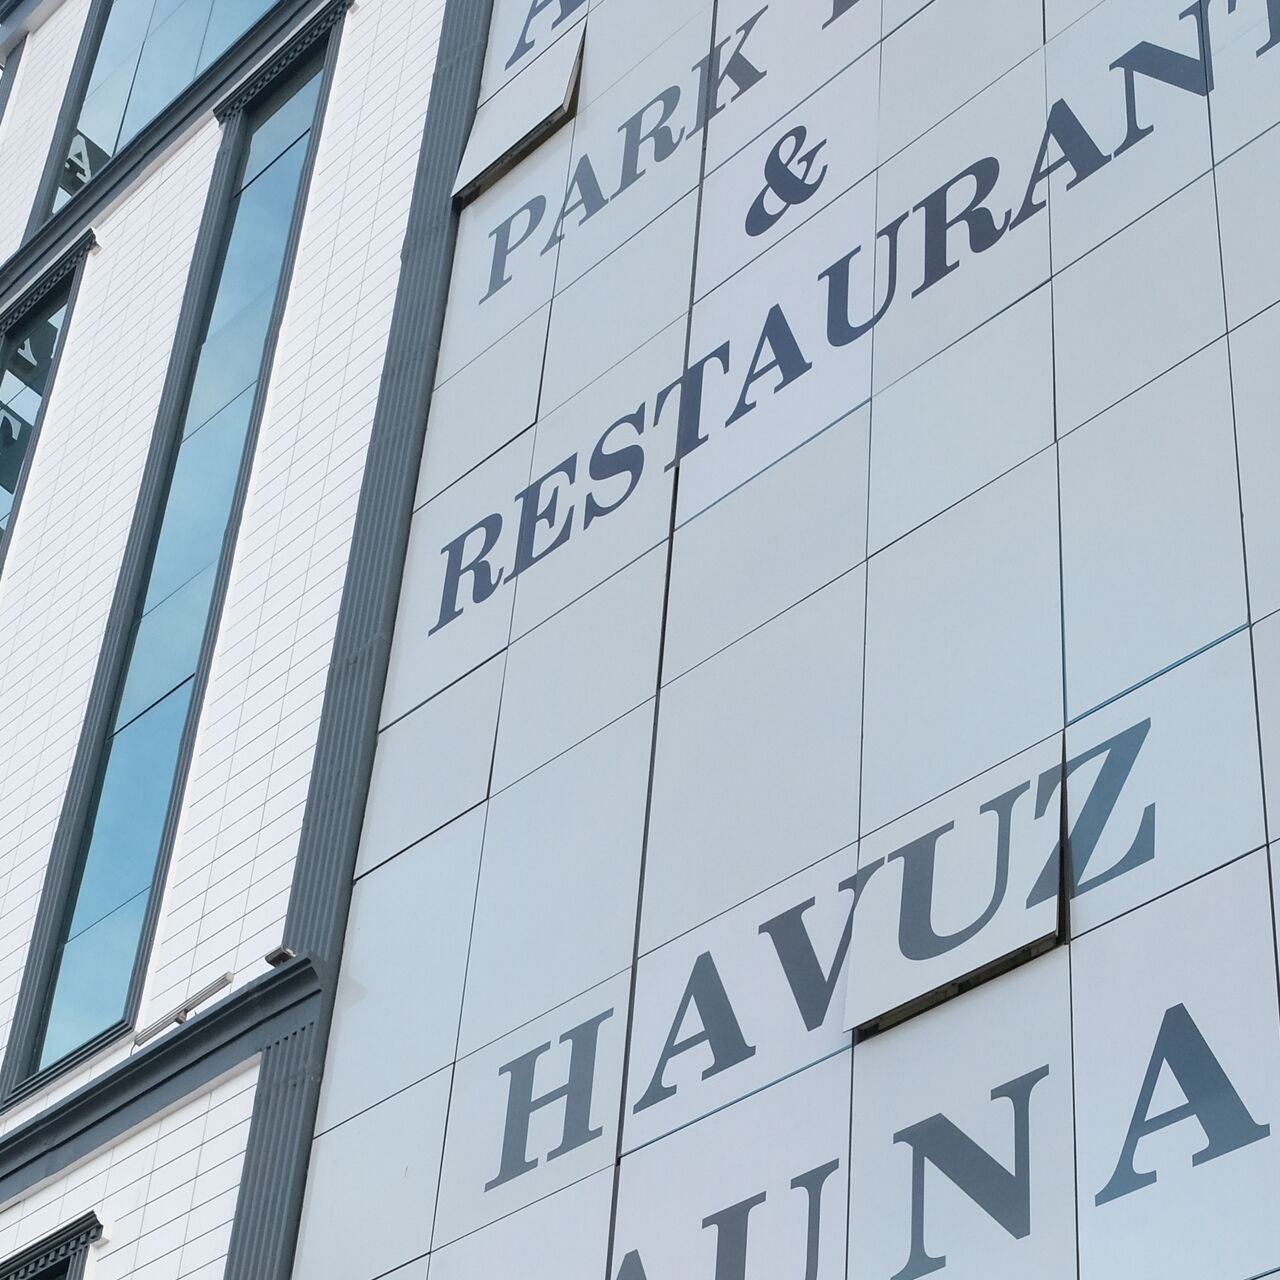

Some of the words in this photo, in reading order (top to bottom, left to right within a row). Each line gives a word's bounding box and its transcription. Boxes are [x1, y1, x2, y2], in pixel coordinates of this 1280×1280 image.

[478, 5, 769, 306] PARK
[745, 125, 829, 238] &
[485, 717, 1156, 1193] HAVUZ
